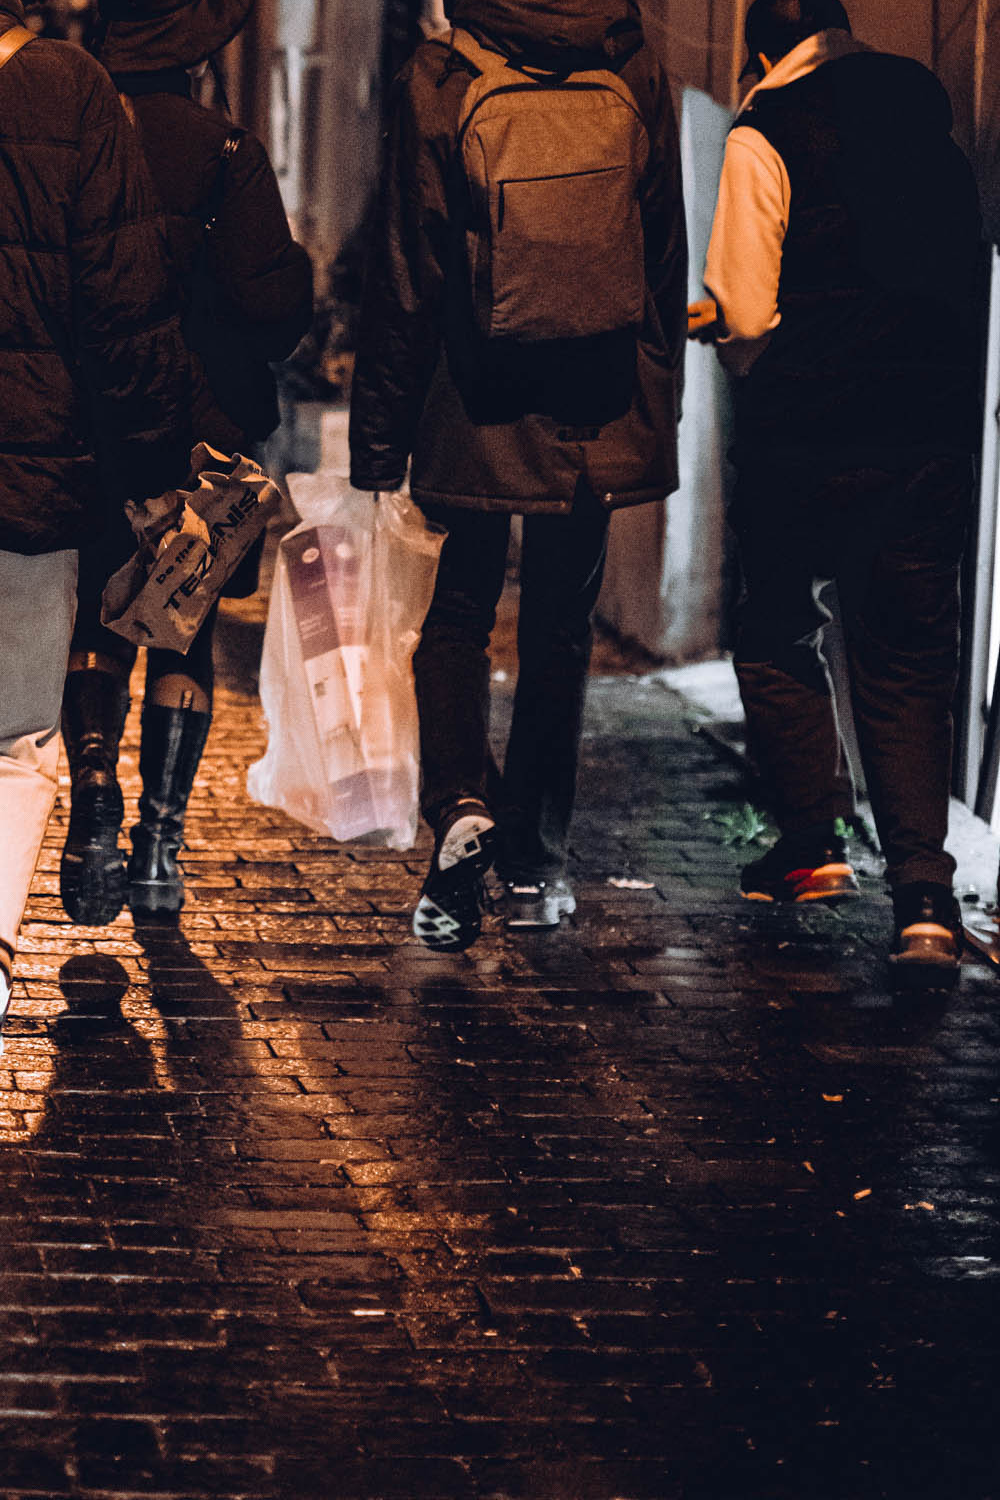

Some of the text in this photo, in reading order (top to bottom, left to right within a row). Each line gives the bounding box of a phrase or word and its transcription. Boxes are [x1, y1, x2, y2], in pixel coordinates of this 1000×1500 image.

[156, 539, 196, 585] be the
[163, 487, 259, 610] TEZENIS
